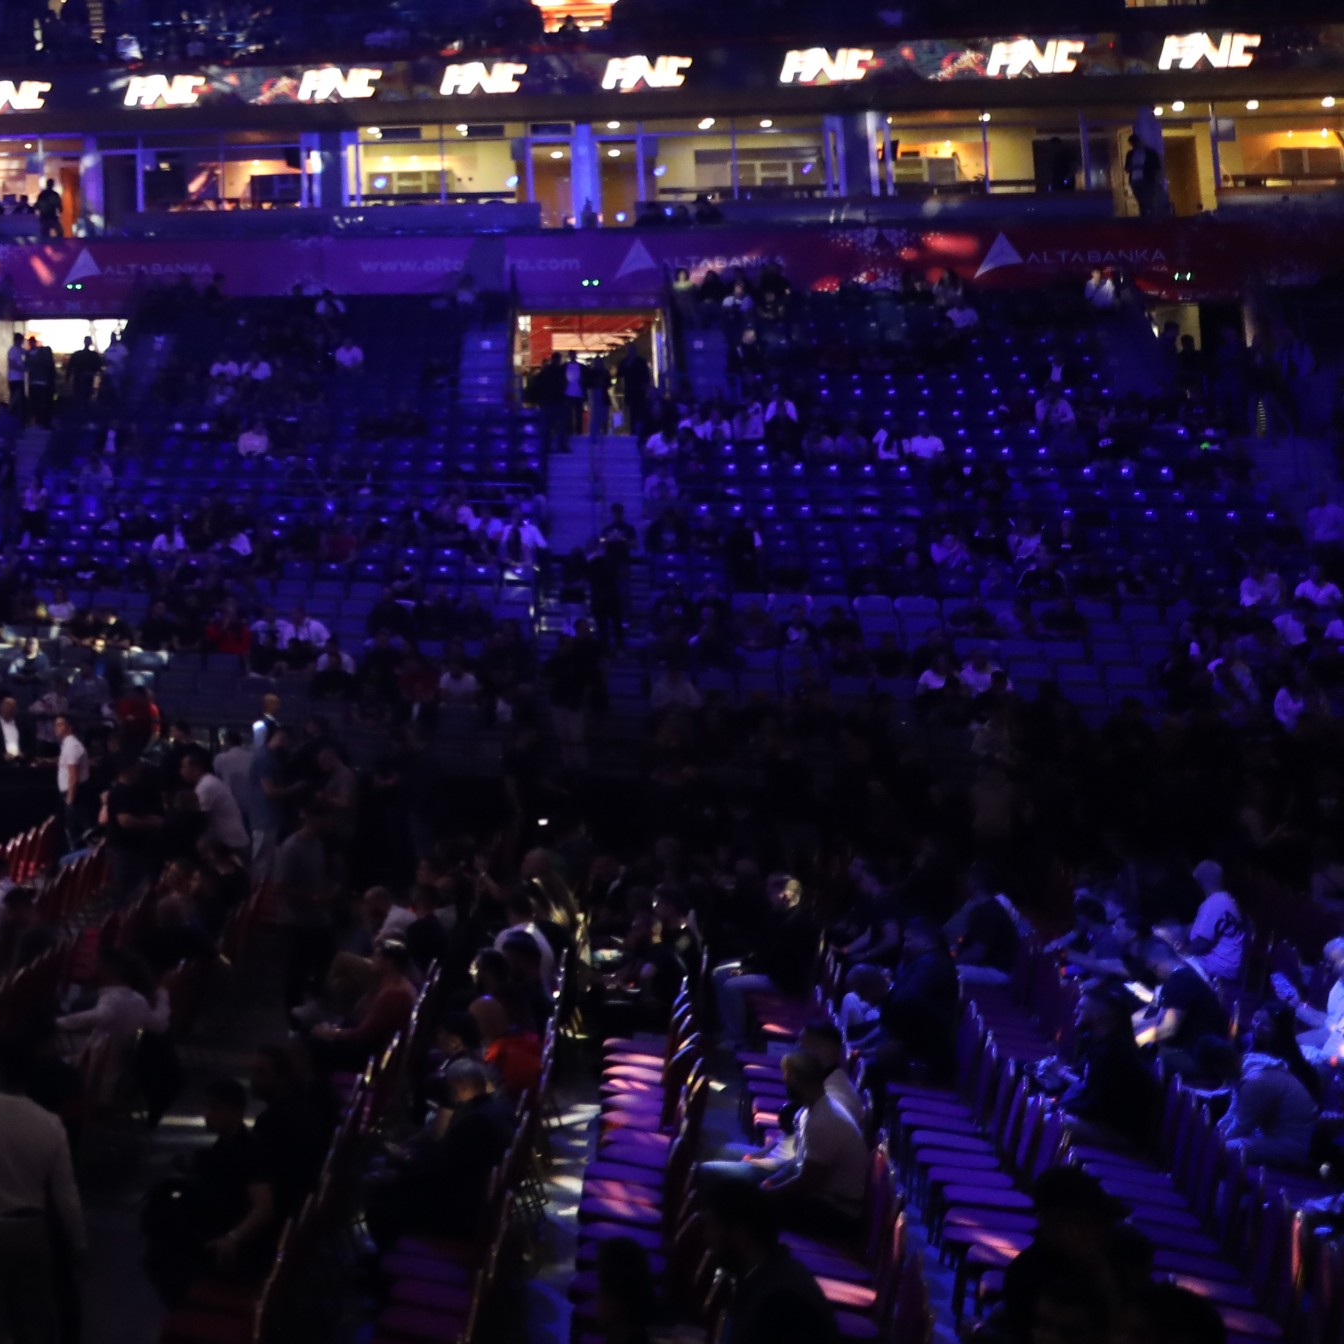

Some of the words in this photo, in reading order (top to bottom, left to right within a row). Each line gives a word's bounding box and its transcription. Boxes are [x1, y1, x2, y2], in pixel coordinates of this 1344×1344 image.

[779, 47, 874, 83] FNC
[986, 38, 1084, 76] FNC
[1157, 31, 1261, 70] FNC
[123, 74, 207, 107] FNC
[296, 67, 383, 100] FNC
[439, 61, 528, 96] FNC
[601, 55, 692, 91] FNC
[360, 256, 581, 273] www.altaa.com
[1026, 248, 1167, 265] ALTABANKA
